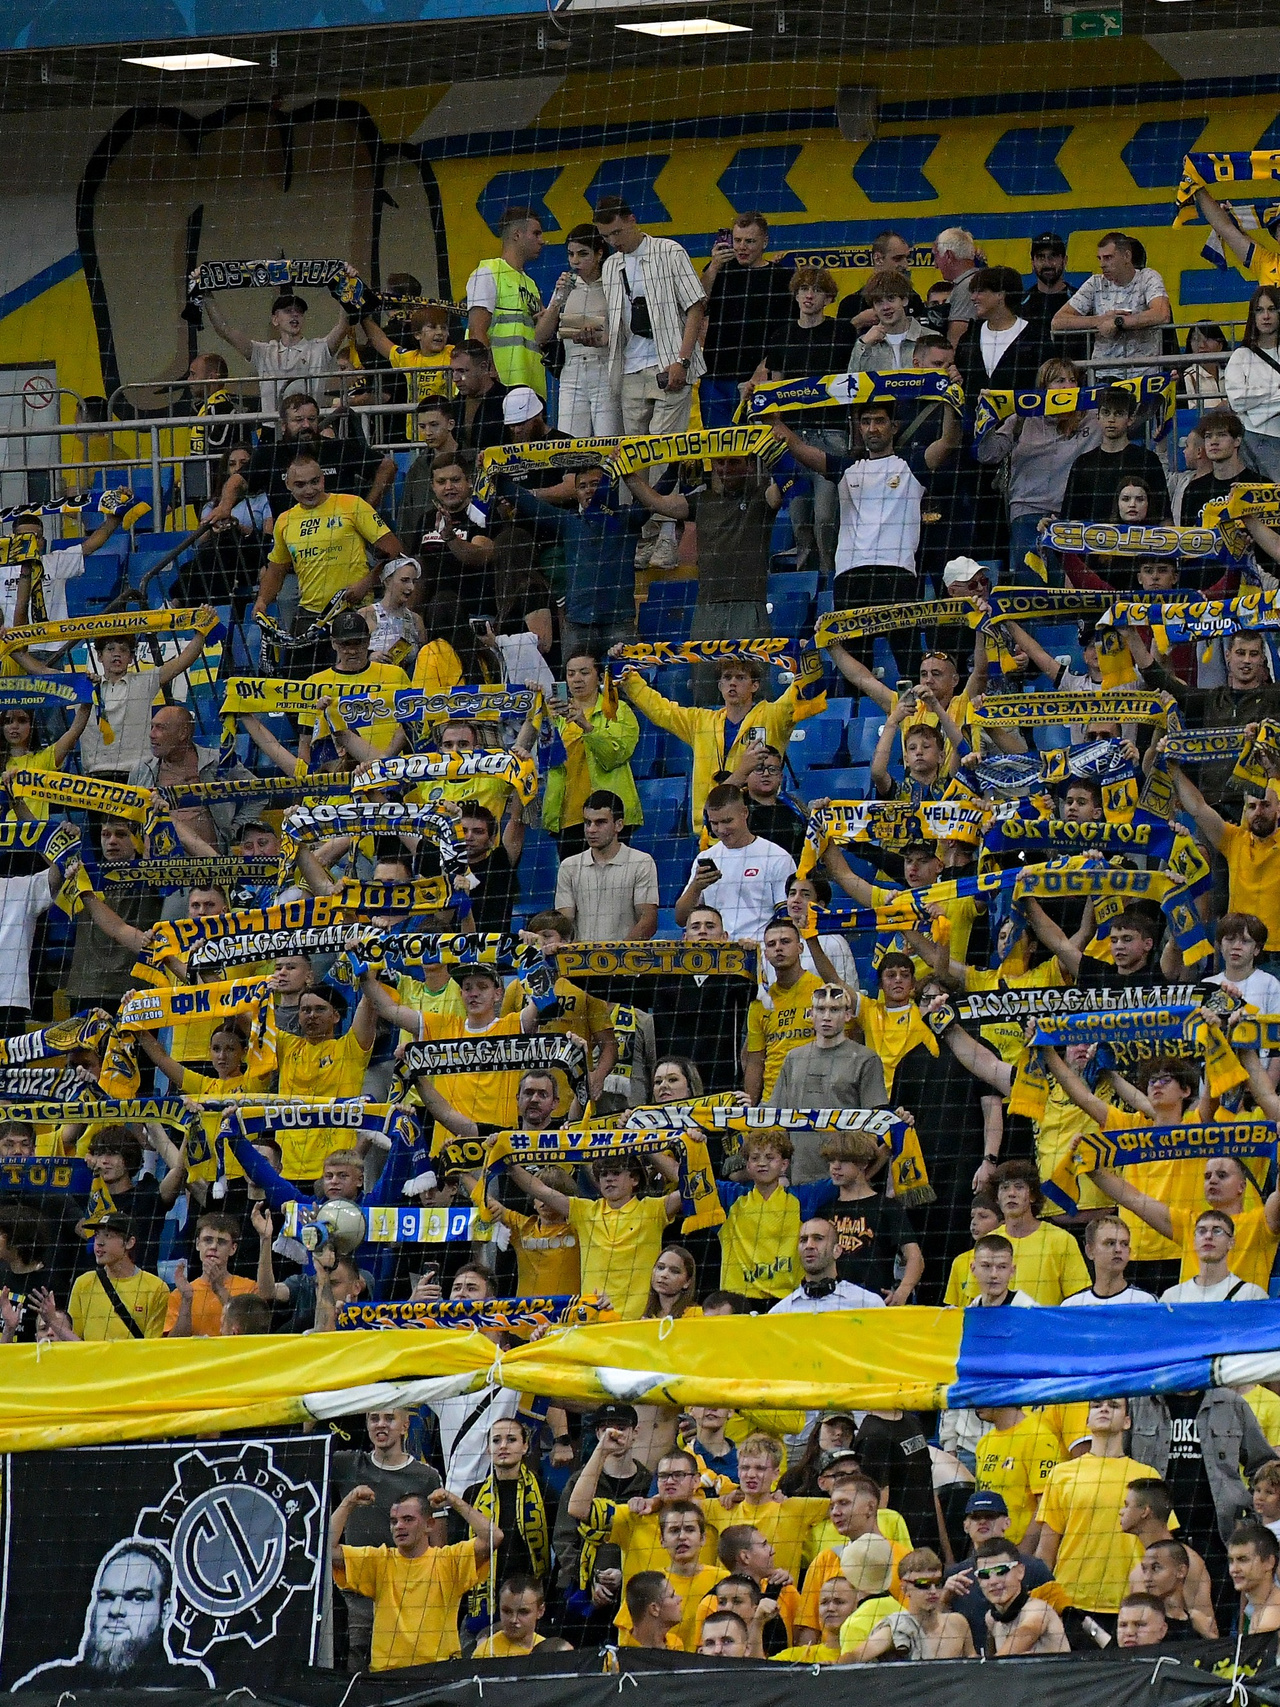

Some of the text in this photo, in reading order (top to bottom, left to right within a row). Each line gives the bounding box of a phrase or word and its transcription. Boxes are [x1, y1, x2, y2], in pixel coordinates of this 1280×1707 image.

[776, 378, 925, 399] Вперёд Ростов!
[502, 445, 524, 455] МЫ
[529, 441, 572, 453] РОСТОВ
[299, 526, 320, 538] BET
[300, 517, 320, 528] FON
[1049, 521, 1221, 556] ОСТОВ
[836, 602, 965, 634] РОСТСЕЛЬМАШ
[236, 681, 265, 701] ФК
[393, 688, 535, 722] РОСТОВ
[988, 701, 1153, 719] РОСТСЕЛЬМАШ
[16, 769, 146, 811] ФК «РОСТОВ»
[173, 772, 351, 798] РОСТСЕЛЬМАШ
[288, 801, 433, 831] ROSTOV
[1049, 820, 1151, 845] РОСТОВ
[118, 865, 267, 882] РОСТСЕЛЬМАШ
[138, 856, 245, 867] ФУТБОЛЬНЫЙ КЛУБ
[1023, 871, 1151, 894] РОСТОВ
[222, 945, 342, 966] РОСТОВ-НА-ДОН
[559, 949, 746, 976] РОСТОВ
[171, 989, 210, 1015] ФК
[777, 1008, 797, 1018] FON
[966, 984, 1194, 1019] РОСТСЕЛЬМАШ
[778, 1017, 796, 1027] BET
[1037, 1010, 1181, 1034] ФК «РОСТОВ»
[8, 1031, 45, 1064] ЮГА
[264, 1103, 365, 1130] РОСТОВ
[625, 1106, 902, 1134] ФК РОСТОВ
[1117, 1124, 1278, 1151] ФК «РОСТОВ»
[378, 1215, 467, 1237] 1930
[212, 1466, 287, 1499] LADS
[181, 1534, 306, 1637] UNITY
